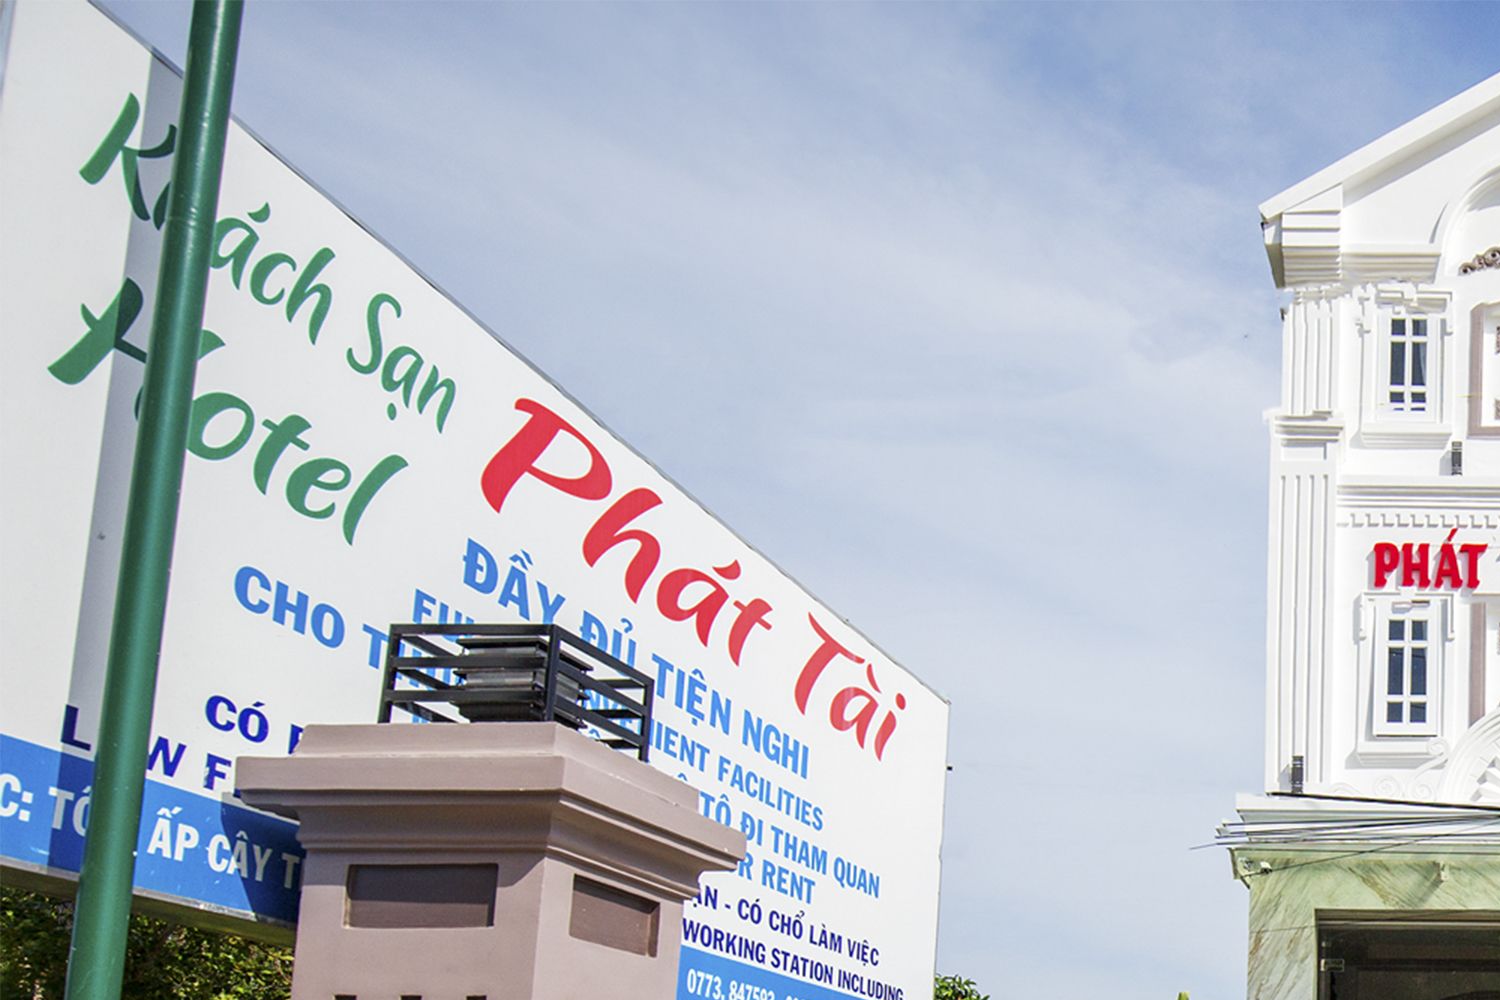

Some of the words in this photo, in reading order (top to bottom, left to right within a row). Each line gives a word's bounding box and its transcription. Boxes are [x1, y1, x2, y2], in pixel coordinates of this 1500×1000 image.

[79, 92, 336, 346] Kách
[346, 293, 457, 434] Sạn
[481, 398, 774, 667] Phát
[794, 611, 907, 762] Tài
[1373, 528, 1488, 591] PHÁT
[234, 566, 345, 649] CHO
[61, 704, 187, 778] LW
[205, 695, 269, 743] CÓ
[651, 653, 732, 736] TIỆN
[742, 710, 809, 779] NGHI
[718, 755, 824, 832] FACILITIES
[147, 806, 199, 862] ẤP
[207, 831, 273, 882] CÂY
[740, 811, 763, 846] ĐI
[771, 825, 828, 875] THAM
[833, 856, 880, 899] QUAN
[761, 859, 816, 905] RENT
[682, 918, 766, 964] WORKING
[771, 948, 833, 985] STATION
[737, 898, 761, 924] CÓ
[809, 923, 842, 953] LÀM
[847, 938, 879, 966] VIỆC
